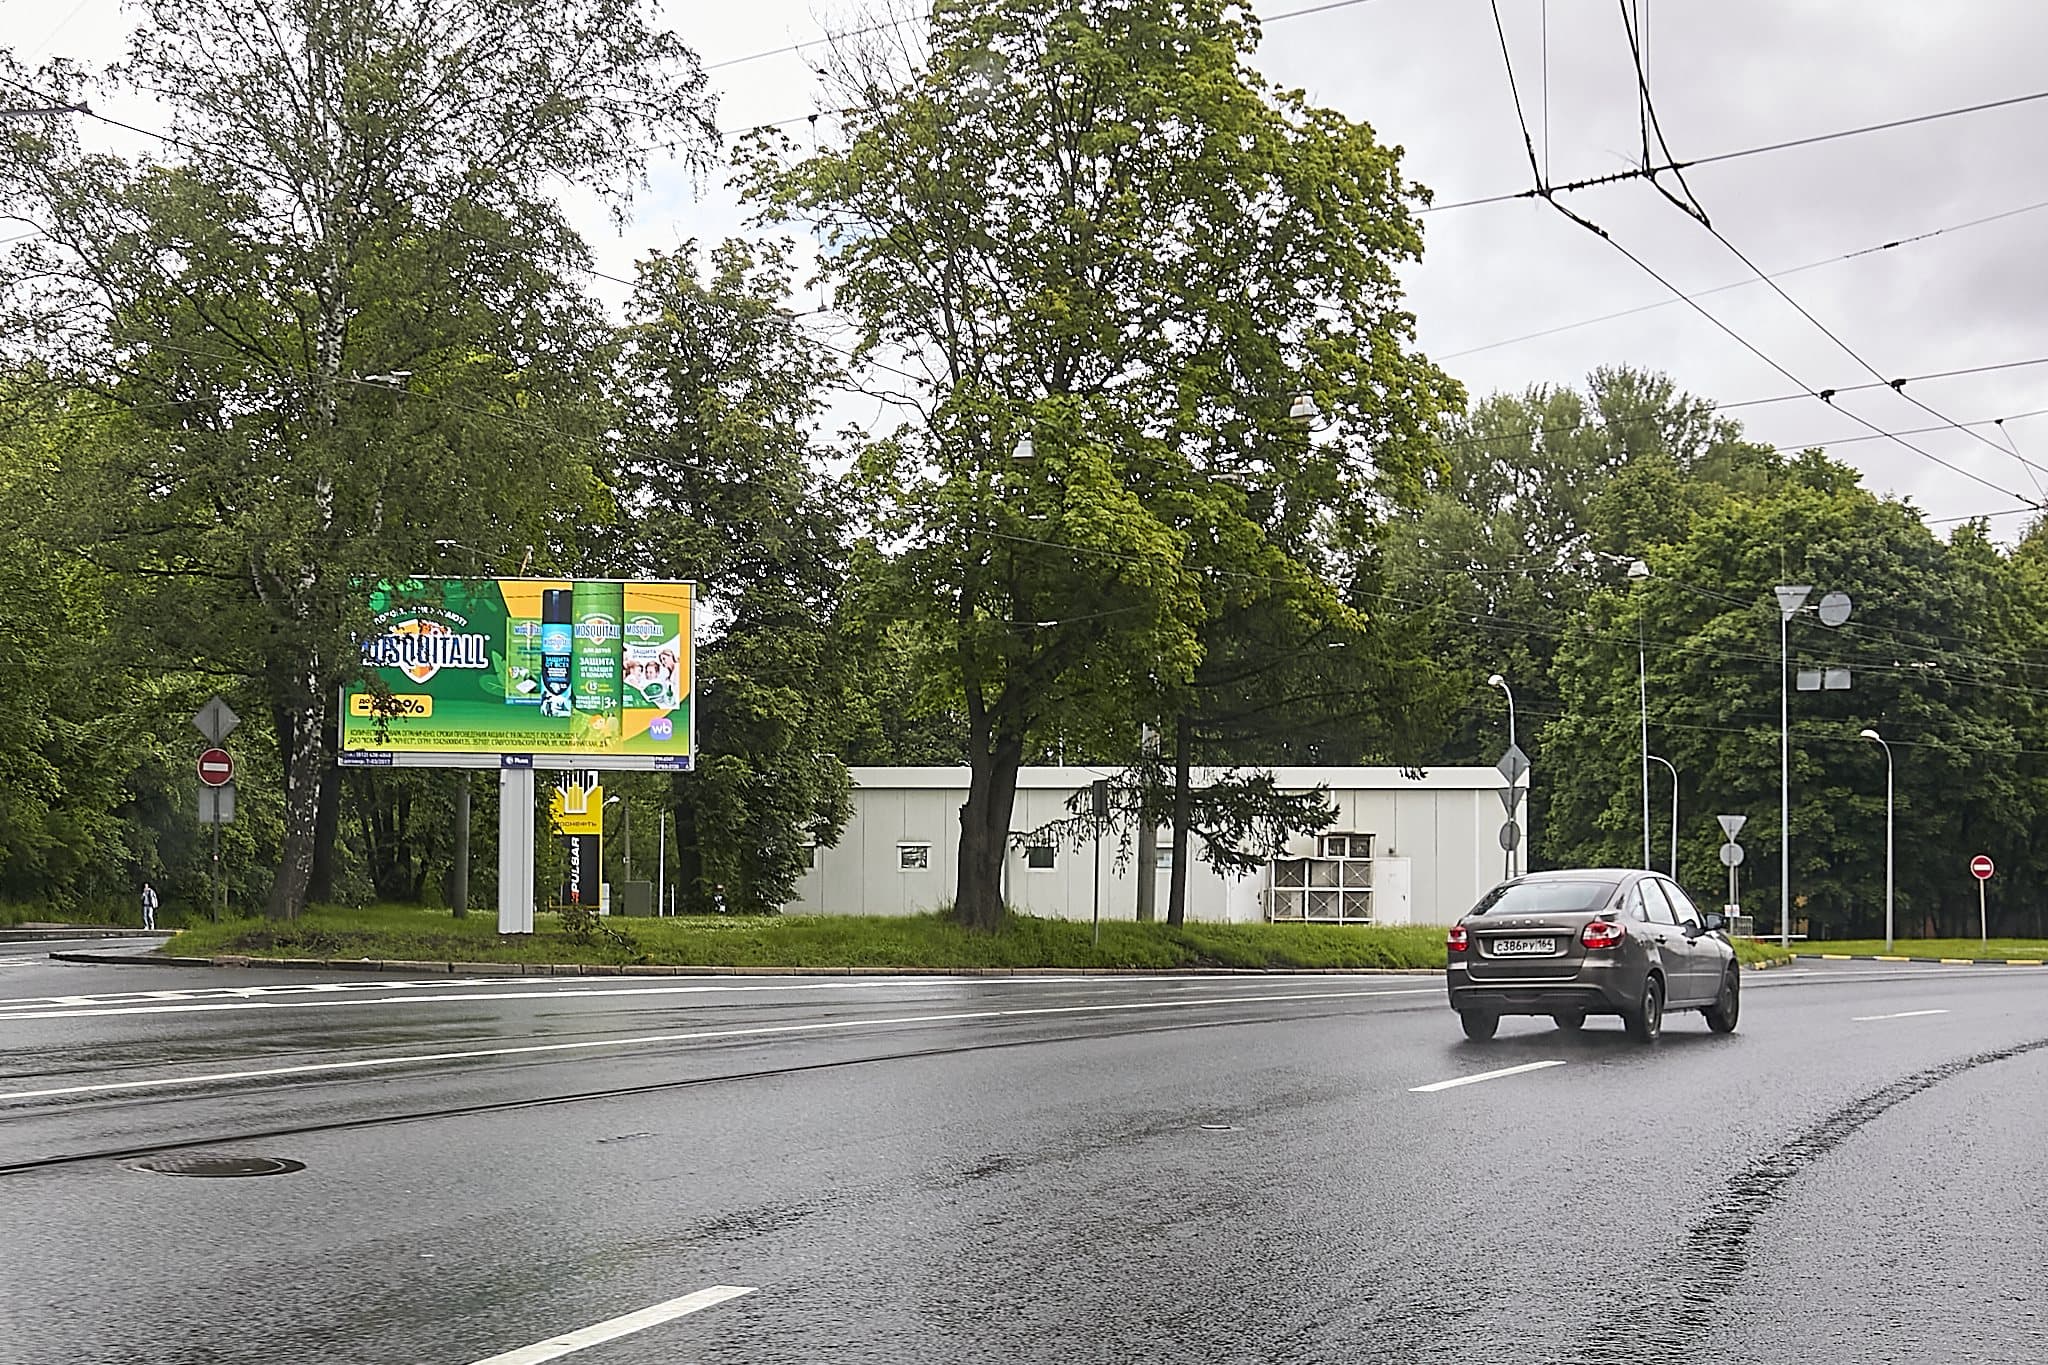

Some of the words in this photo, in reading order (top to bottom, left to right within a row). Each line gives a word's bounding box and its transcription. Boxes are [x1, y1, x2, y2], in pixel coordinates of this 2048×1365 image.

[575, 624, 621, 638] MOSQUITALL
[626, 624, 663, 635] MOSQUITALL
[361, 632, 487, 667] OSQUITALL
[579, 657, 615, 666] ЗАЩИТА
[604, 696, 617, 709] 3+
[652, 722, 671, 734] wb
[571, 836, 580, 892] PULSAR
